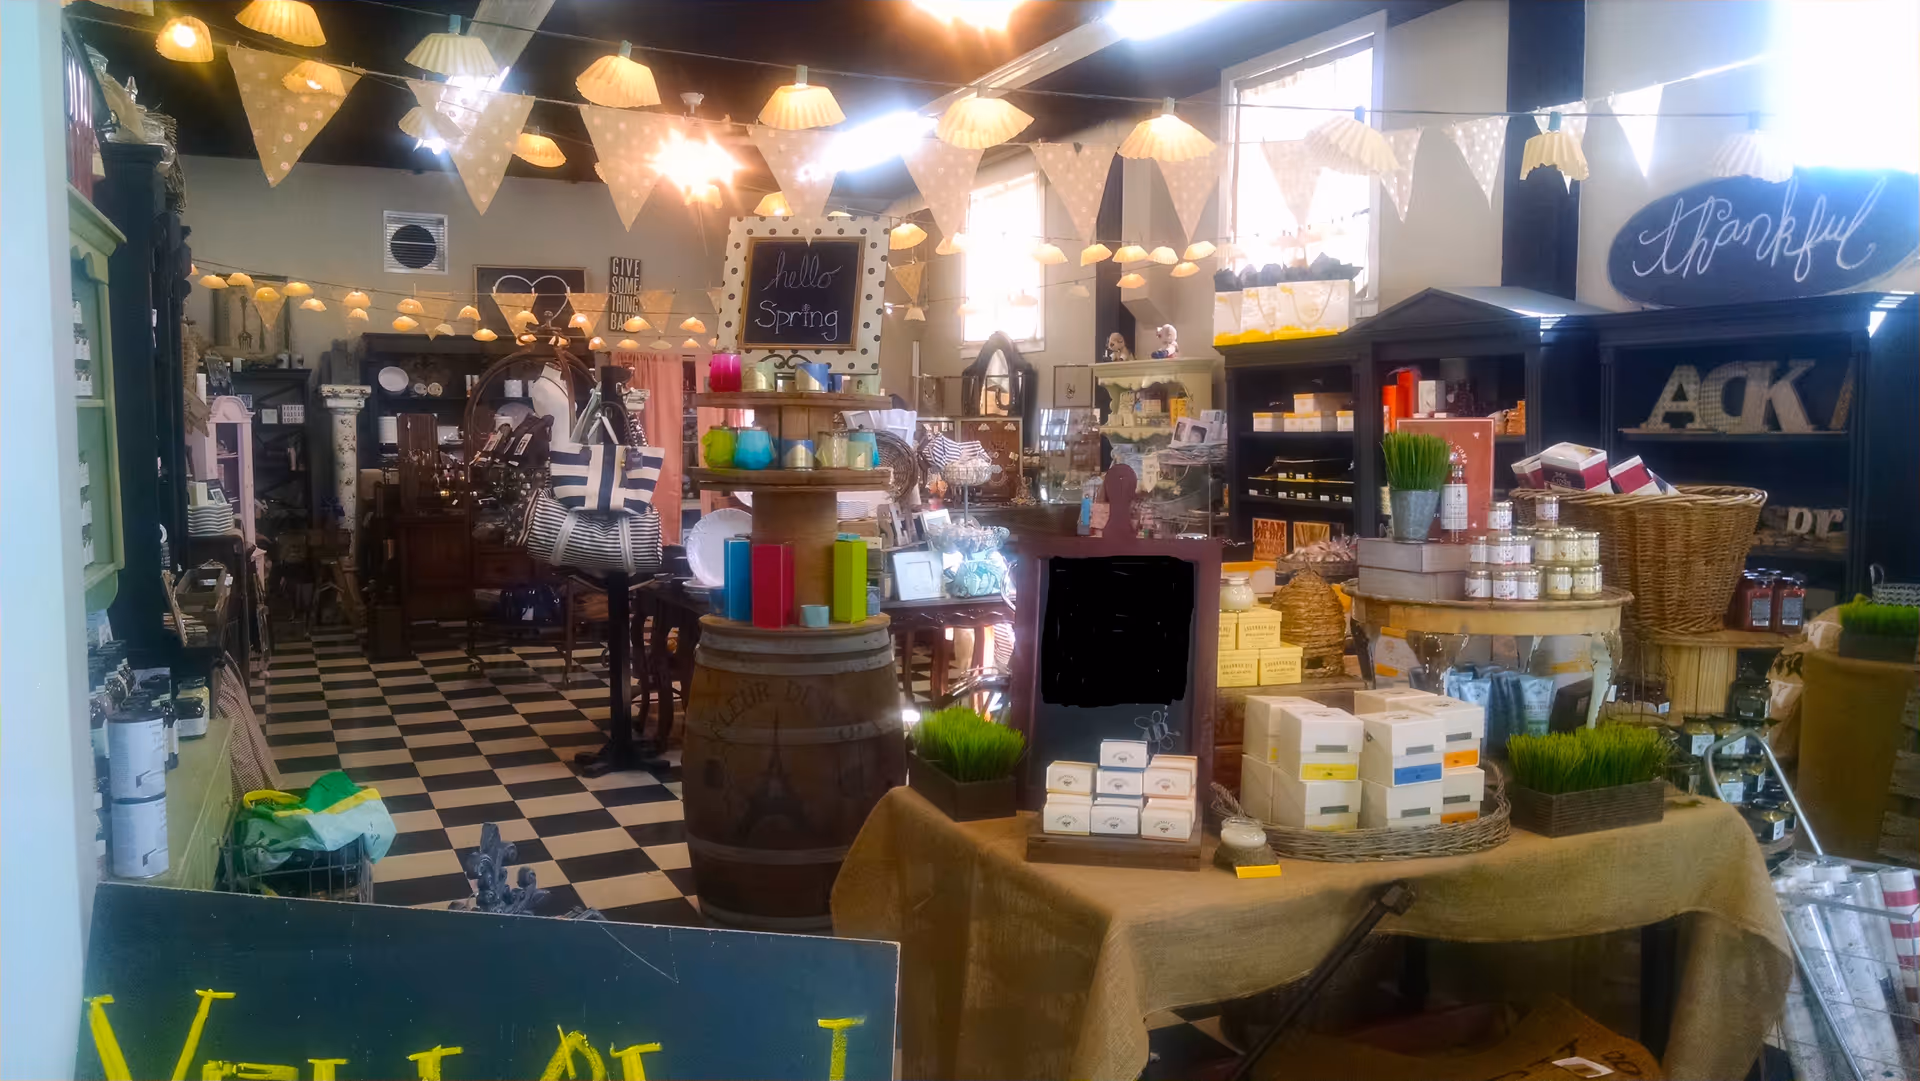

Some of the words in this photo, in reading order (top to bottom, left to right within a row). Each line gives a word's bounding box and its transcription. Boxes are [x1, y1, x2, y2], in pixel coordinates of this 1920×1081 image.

[1632, 175, 1887, 282] thankful
[612, 257, 640, 277] GIVE
[760, 249, 844, 291] hello
[611, 275, 640, 295] SOME
[612, 294, 639, 313] THING
[754, 299, 839, 341] Spring
